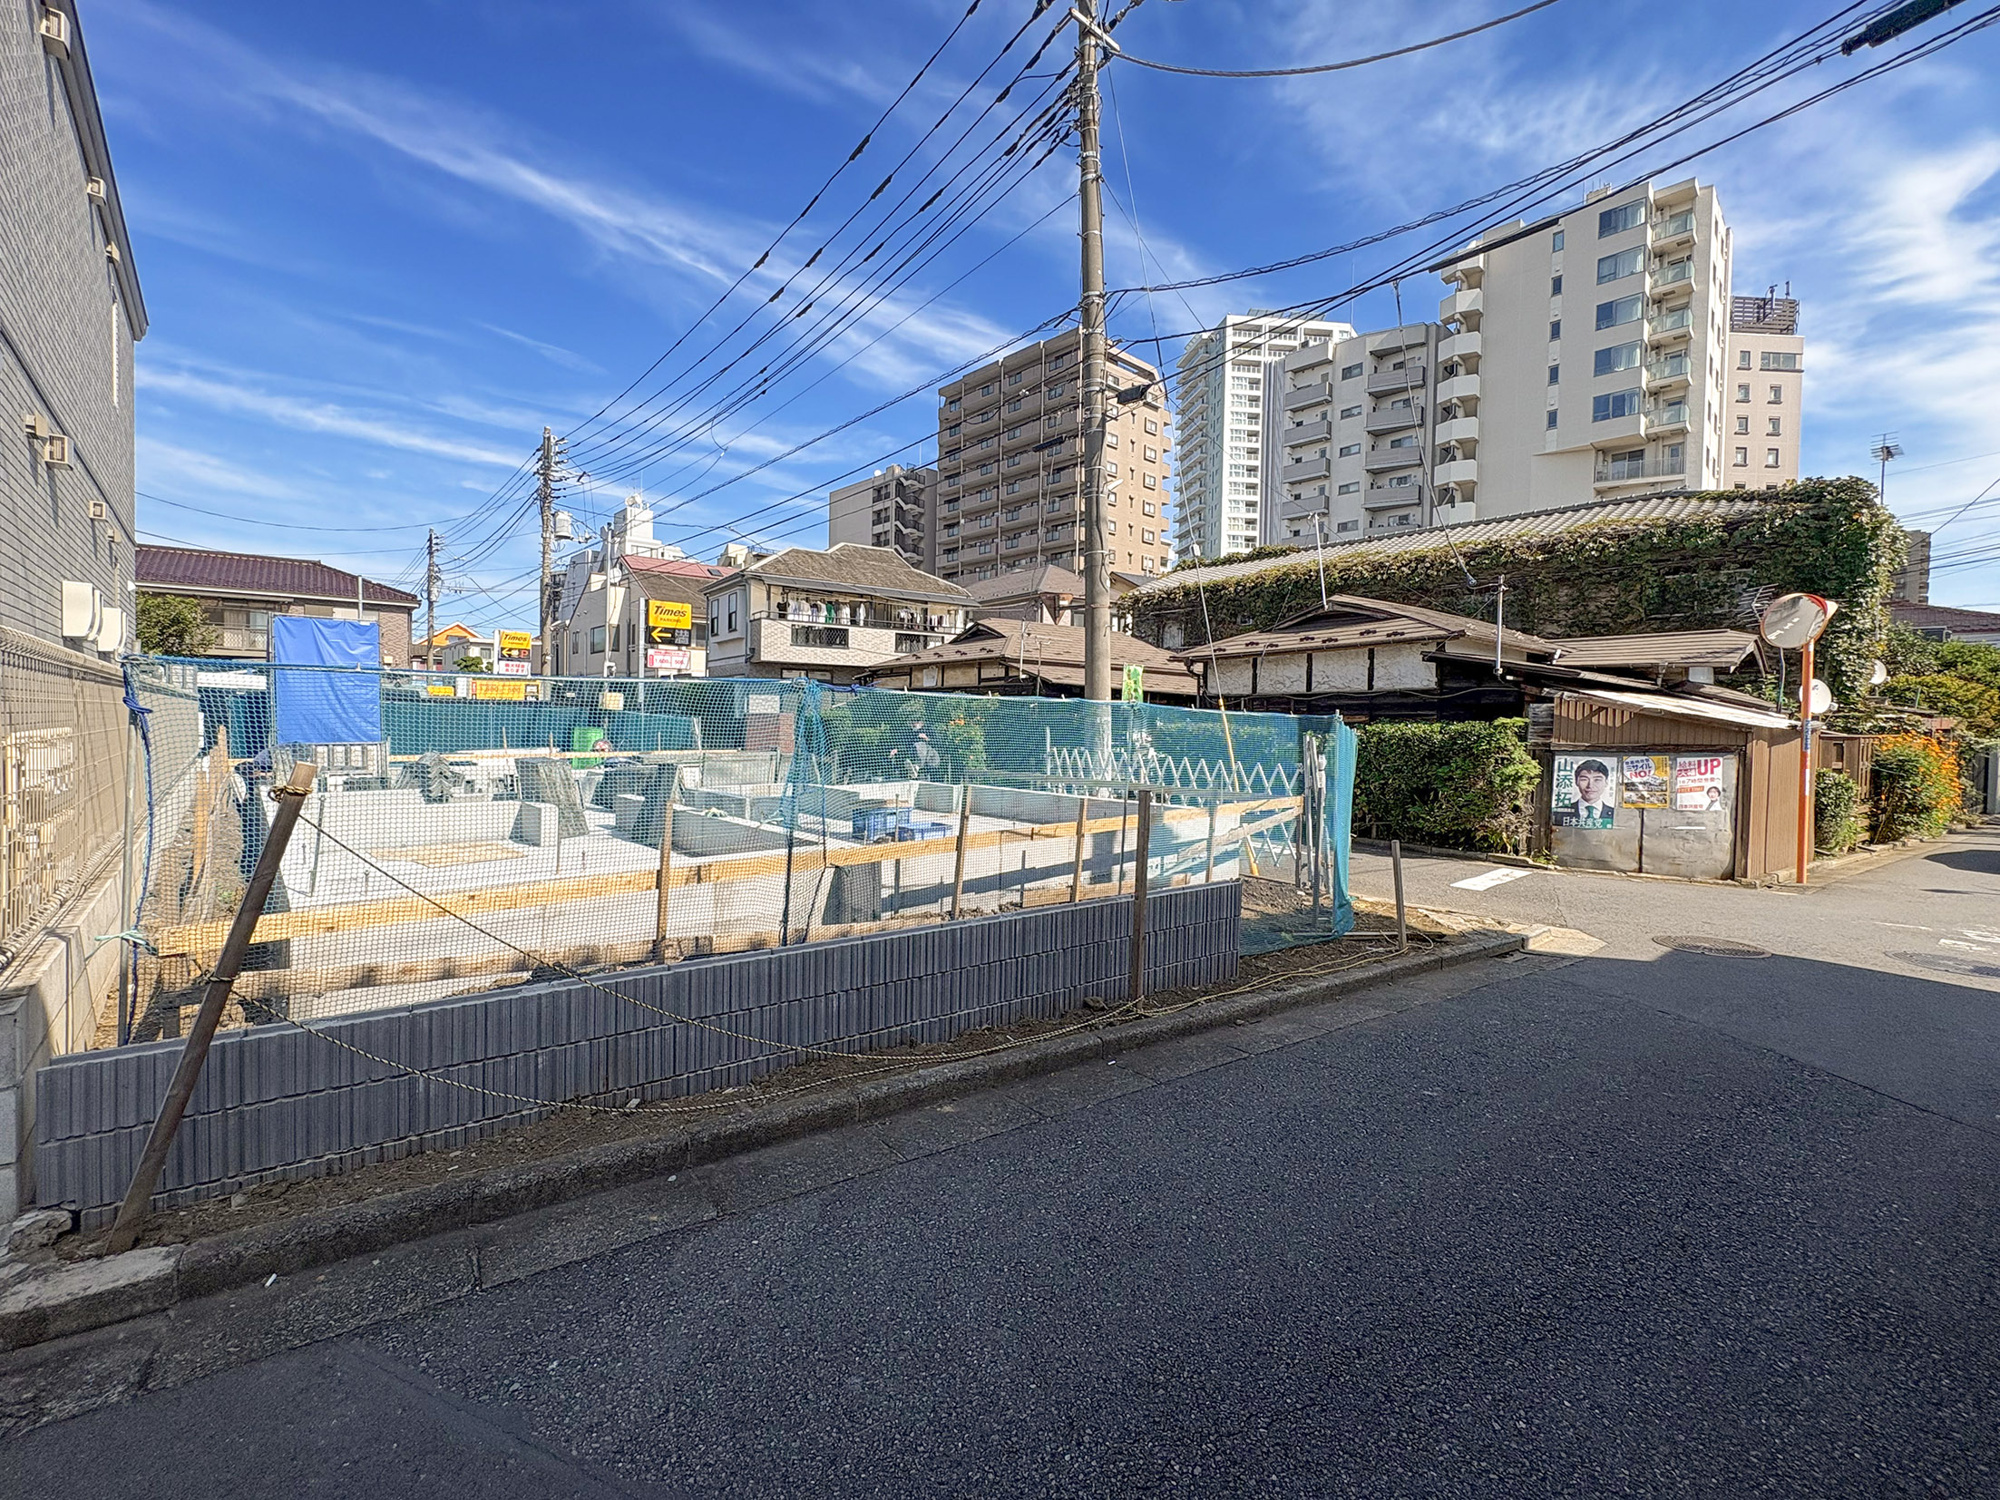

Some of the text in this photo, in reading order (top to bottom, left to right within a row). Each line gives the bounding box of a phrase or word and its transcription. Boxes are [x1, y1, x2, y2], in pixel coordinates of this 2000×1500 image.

[654, 605, 687, 617] Times
[1626, 763, 1652, 772] ミサイル
[1697, 758, 1721, 776] UP
[1630, 770, 1652, 779] NO!
[1555, 758, 1574, 807] 山添拓
[1563, 816, 1602, 828] 日本共産党
